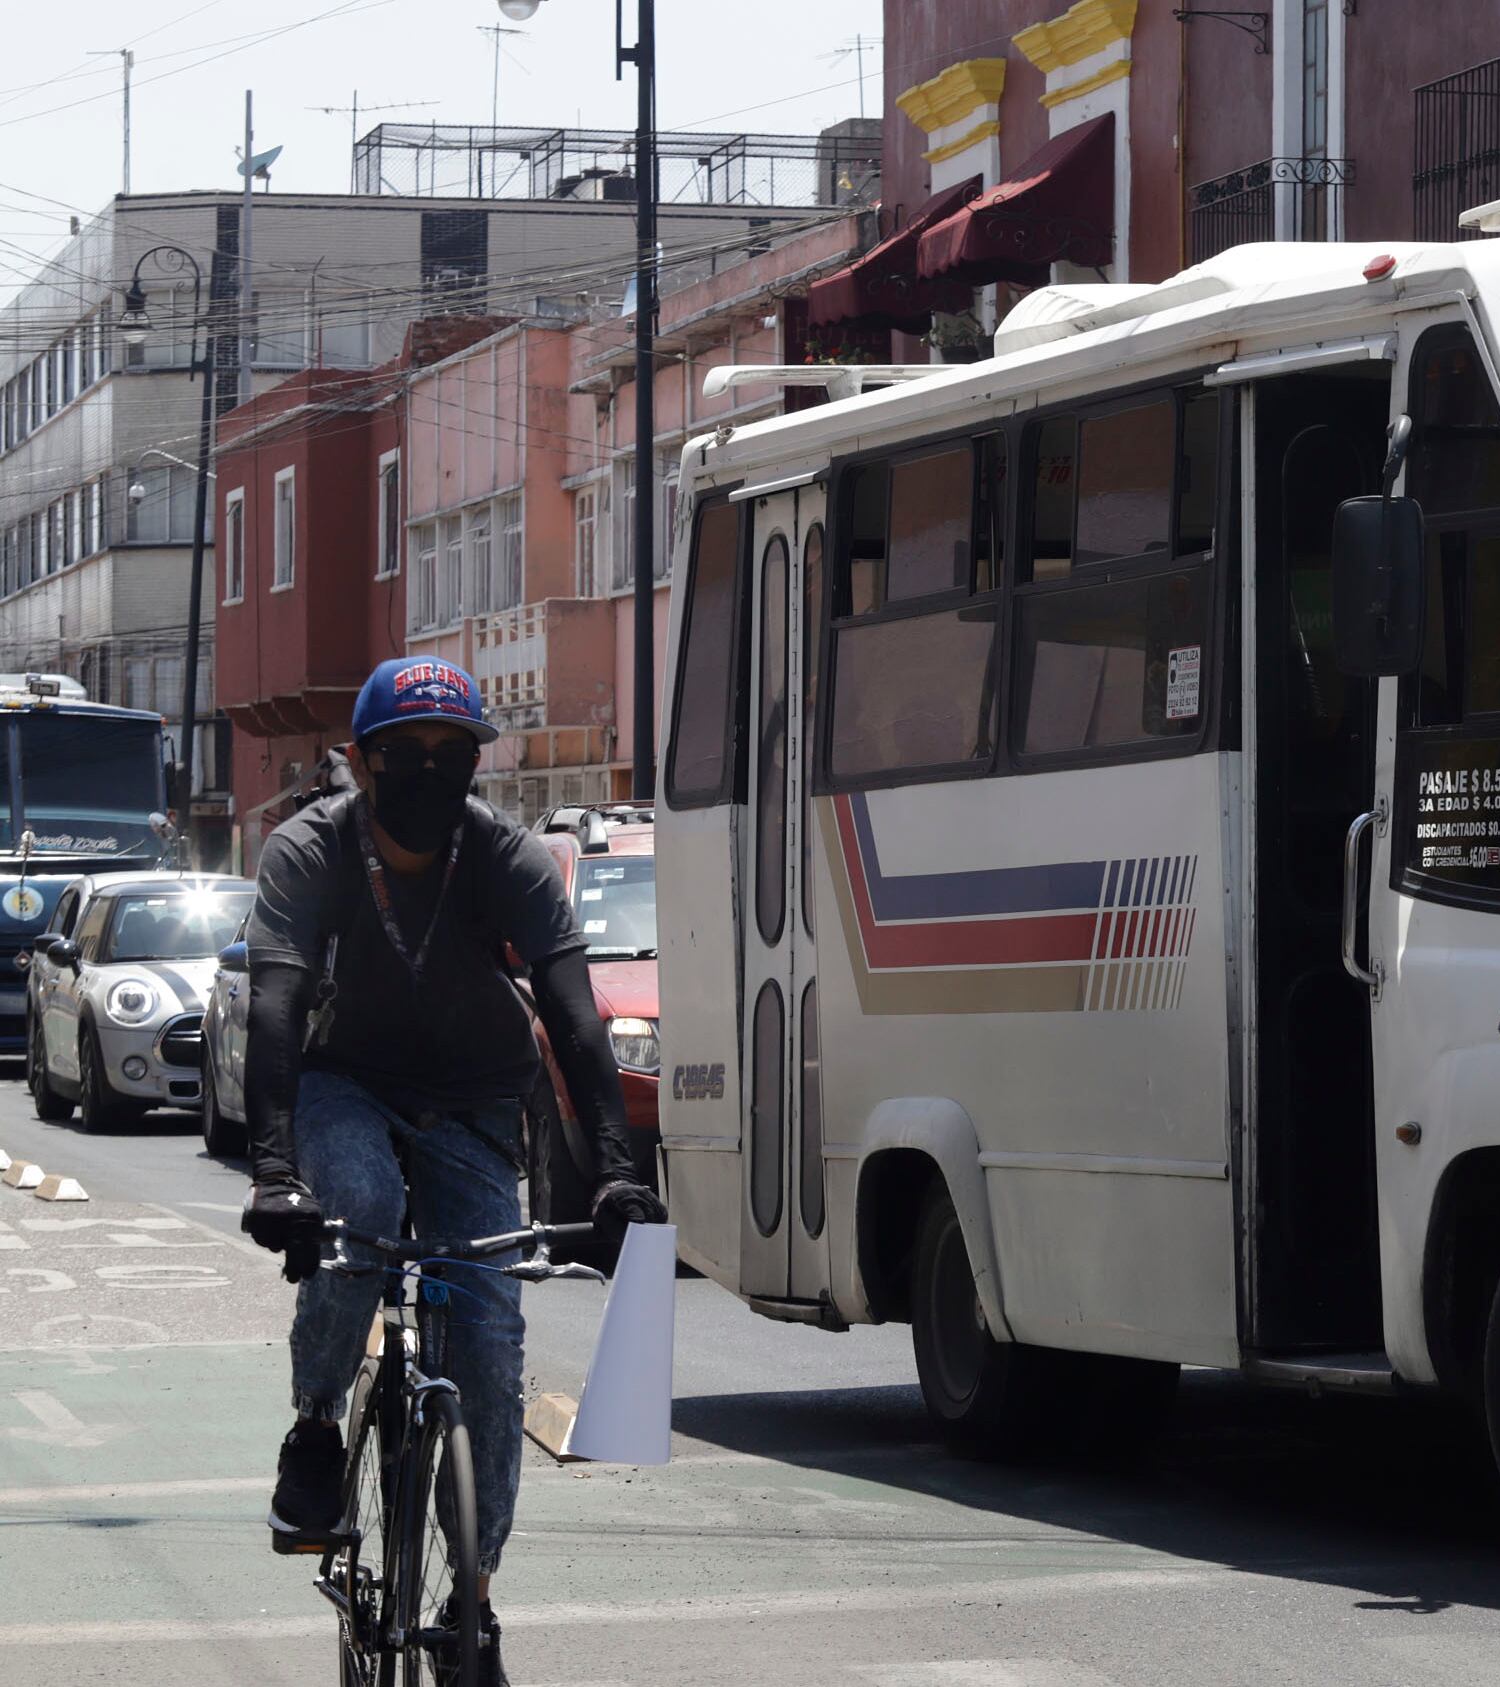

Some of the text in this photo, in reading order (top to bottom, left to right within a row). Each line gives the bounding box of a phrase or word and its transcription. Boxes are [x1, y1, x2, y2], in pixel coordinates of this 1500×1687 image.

[1179, 650, 1199, 661] UTILIZA
[394, 663, 470, 700] BLUE JAYS
[1419, 770, 1468, 795] PASAJE
[1471, 768, 1479, 795] $
[1418, 798, 1434, 812] 3A
[1437, 797, 1469, 811] EDAD
[1472, 796, 1480, 811] $
[1417, 822, 1487, 838] DISCAPACITADOS
